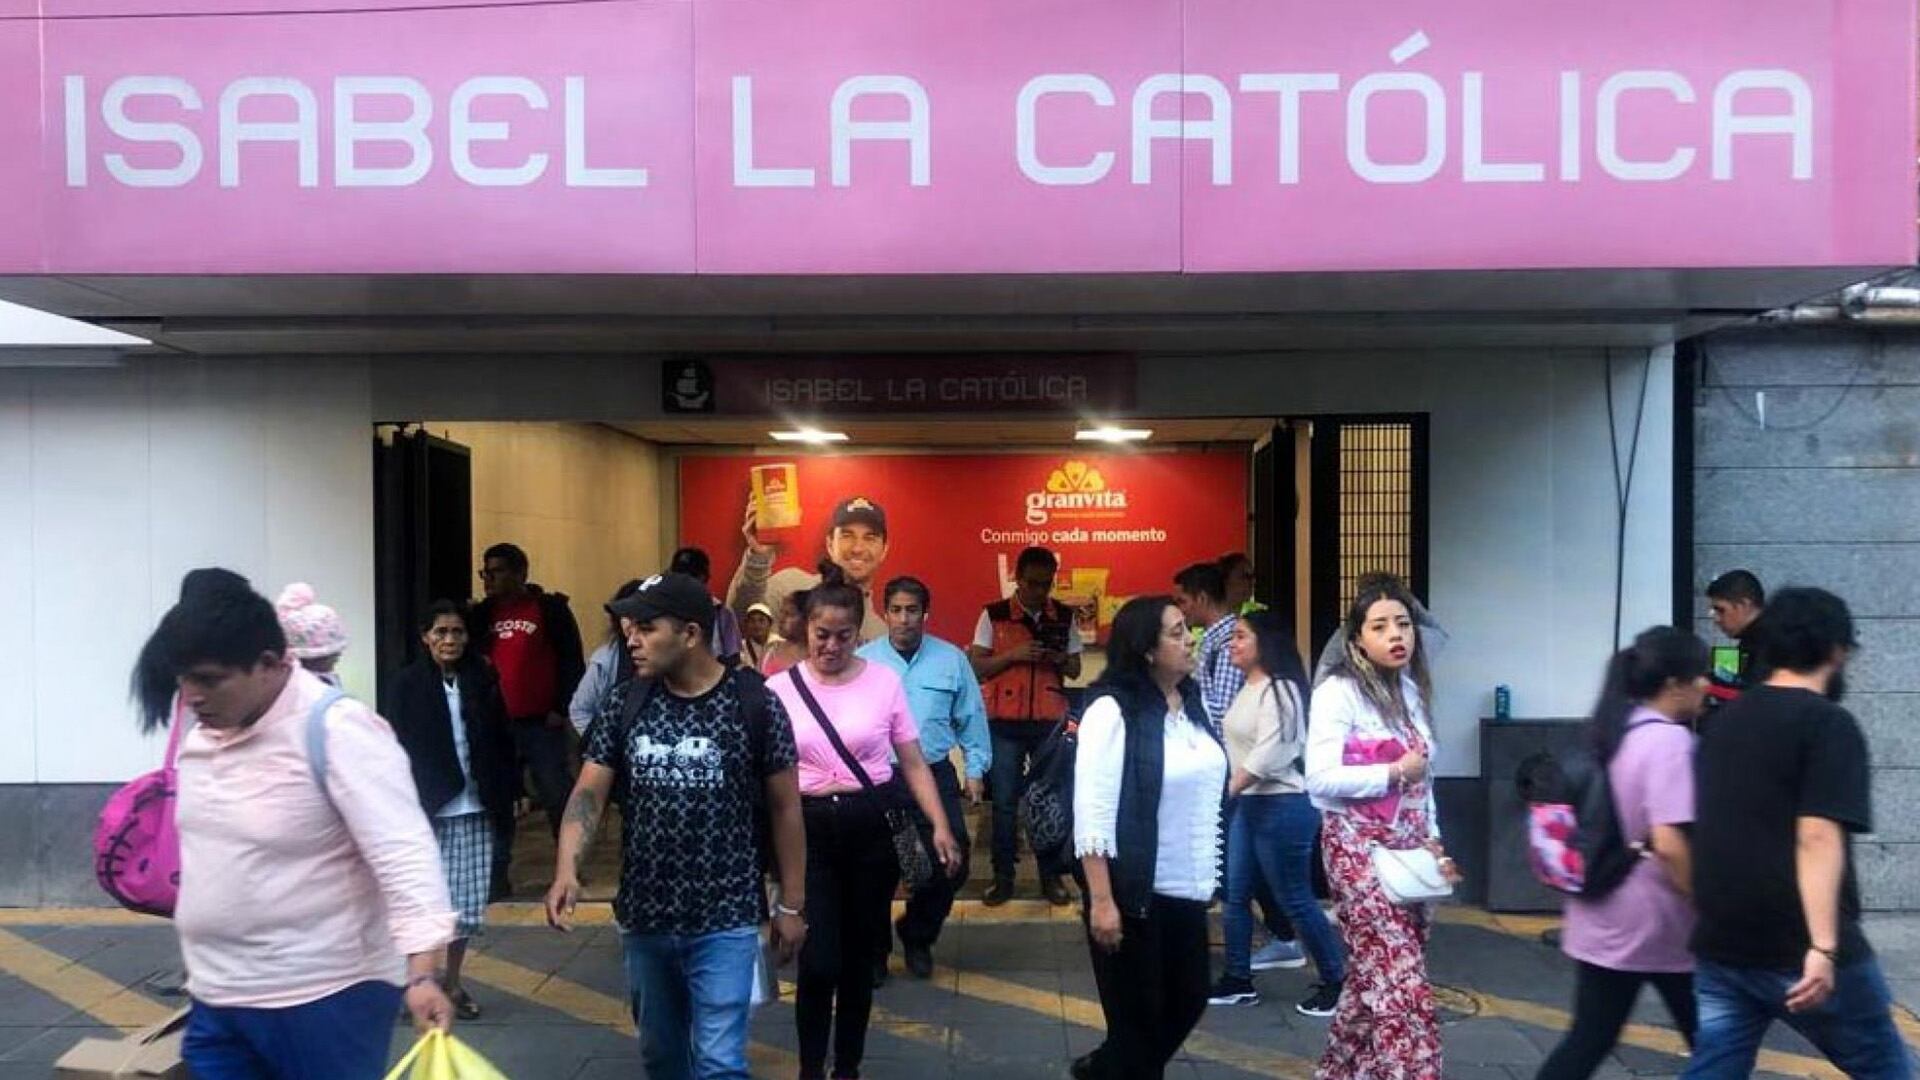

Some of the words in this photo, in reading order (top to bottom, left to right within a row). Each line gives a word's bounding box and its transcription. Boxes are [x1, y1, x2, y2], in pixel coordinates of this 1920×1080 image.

[63, 73, 649, 190] ISABEL
[731, 73, 931, 190] LA
[1014, 31, 1817, 187] CATÓLICA
[765, 377, 875, 402] ISABEL
[888, 377, 926, 401] LA
[939, 370, 1088, 401] CATÓLICA
[1025, 489, 1126, 525] granvita
[981, 528, 1048, 547] Conmigo
[1051, 526, 1089, 542] cada
[1092, 528, 1167, 542] momento
